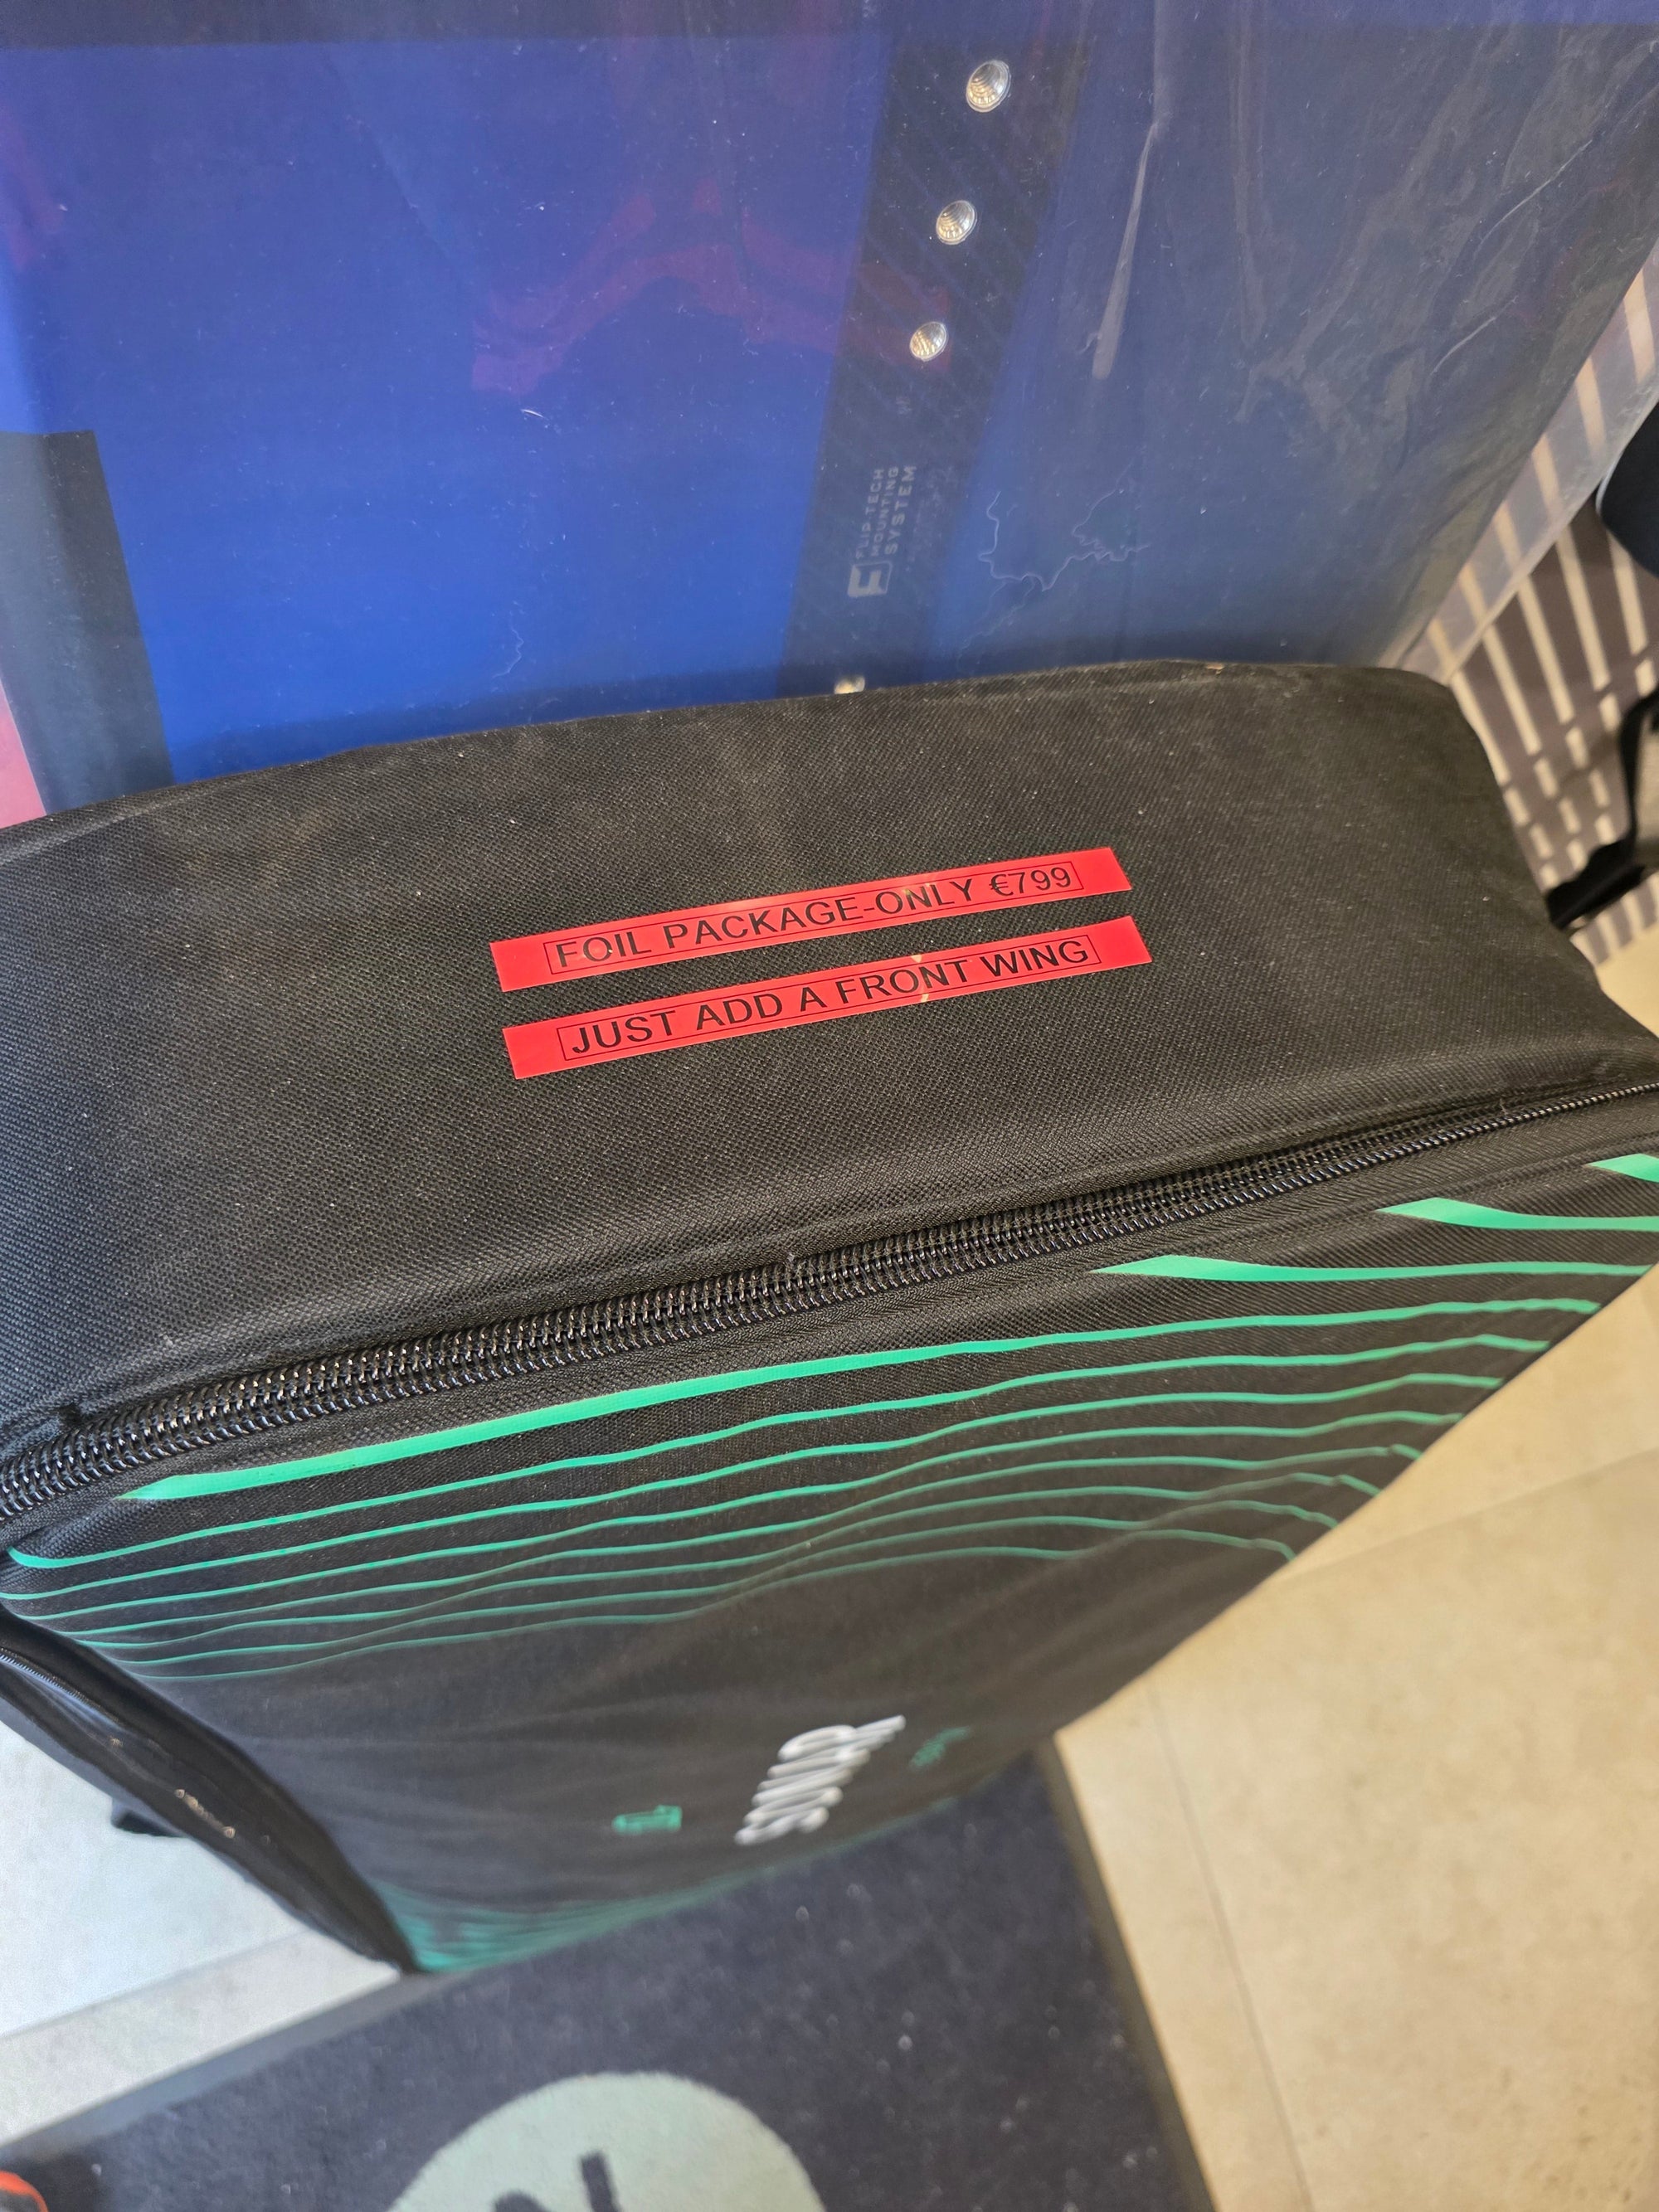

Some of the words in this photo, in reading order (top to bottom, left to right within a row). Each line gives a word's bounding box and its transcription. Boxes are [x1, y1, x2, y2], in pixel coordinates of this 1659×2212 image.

[871, 466, 899, 557] MOUNTING
[884, 464, 917, 555] SYSTEM
[556, 931, 652, 968] FOIL
[663, 878, 973, 949] PACKAGE-ONLY
[989, 866, 1072, 897] €799
[572, 1009, 677, 1054] JUST
[696, 993, 782, 1031] ADD
[800, 986, 827, 1011] A
[835, 959, 969, 1004] FRONT
[980, 940, 1088, 977] WING
